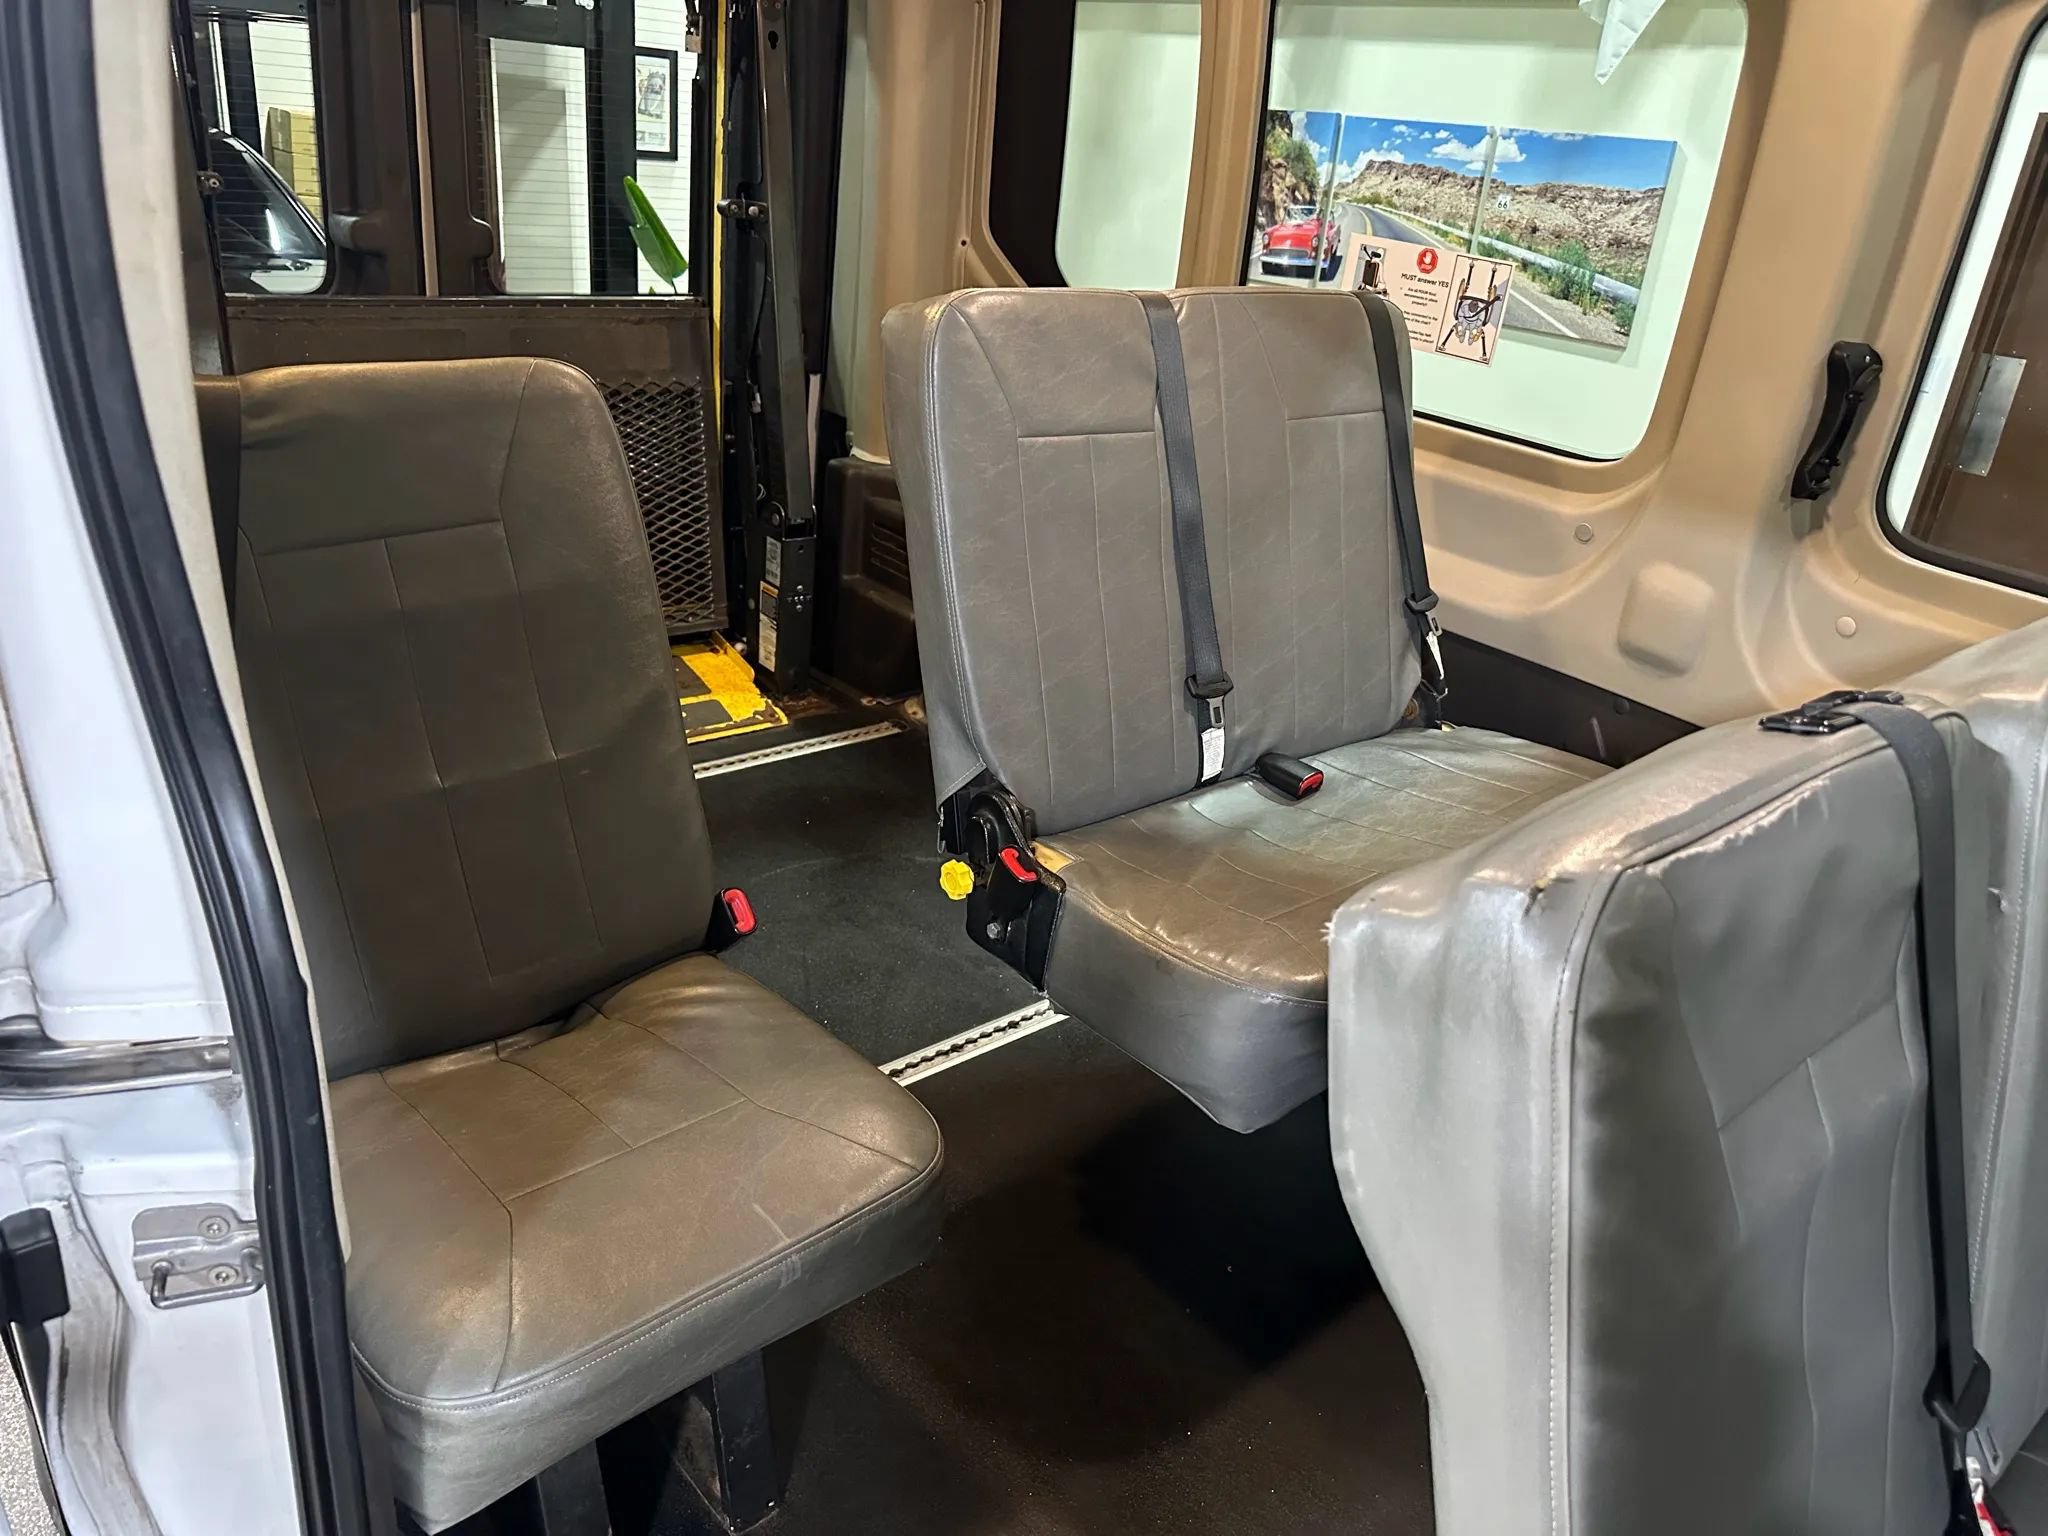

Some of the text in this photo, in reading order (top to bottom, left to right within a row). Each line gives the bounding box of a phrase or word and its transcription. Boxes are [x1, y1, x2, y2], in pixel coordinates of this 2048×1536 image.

[1497, 200, 1508, 209] 66
[1401, 273, 1449, 288] MUST answer YES
